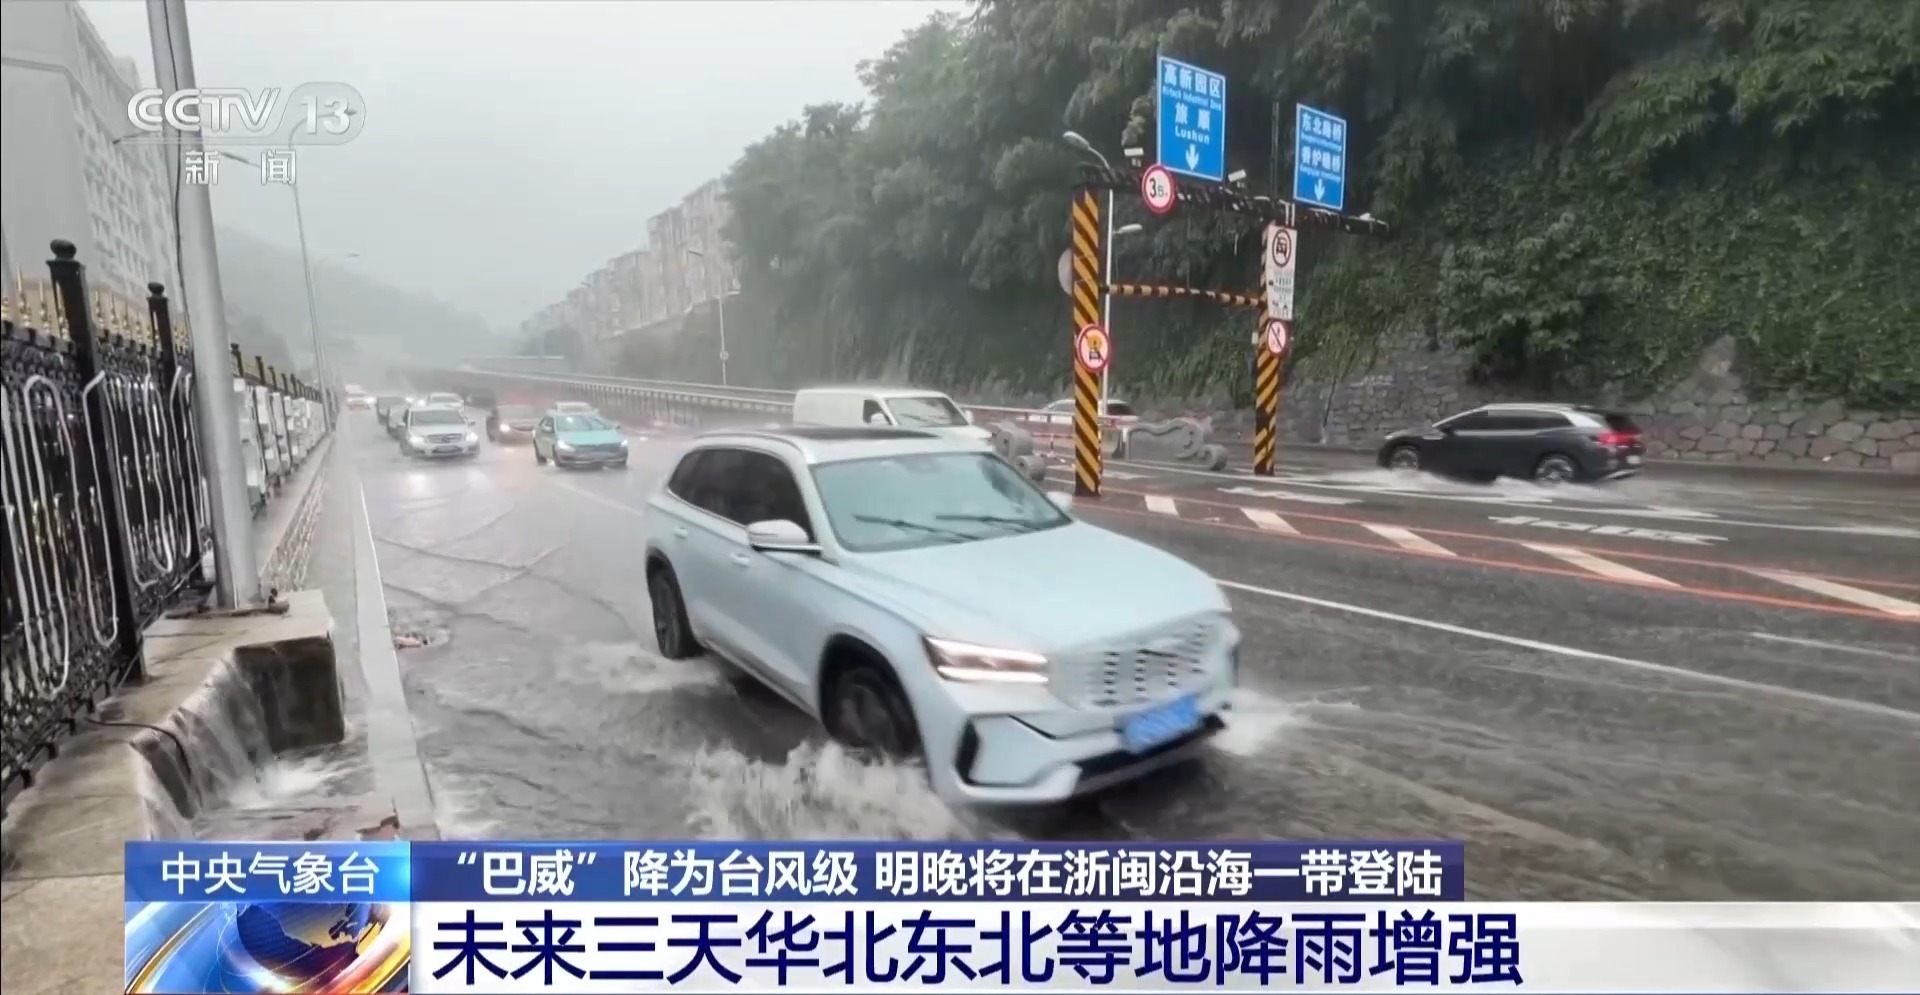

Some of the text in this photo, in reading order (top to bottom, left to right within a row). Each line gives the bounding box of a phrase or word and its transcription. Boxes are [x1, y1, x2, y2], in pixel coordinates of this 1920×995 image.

[1164, 63, 1221, 98] 高新园区
[1175, 125, 1210, 144] Lushun
